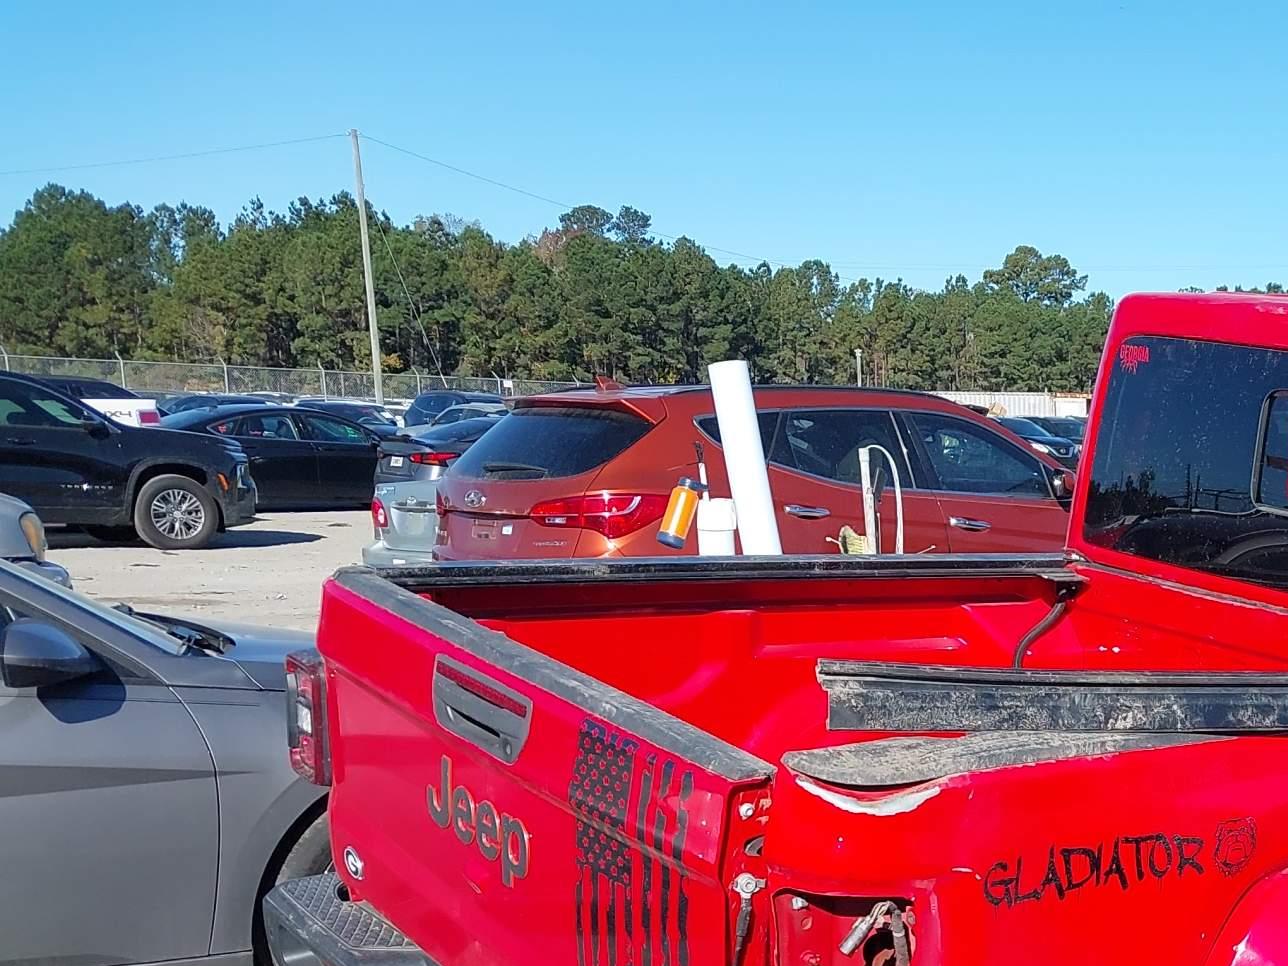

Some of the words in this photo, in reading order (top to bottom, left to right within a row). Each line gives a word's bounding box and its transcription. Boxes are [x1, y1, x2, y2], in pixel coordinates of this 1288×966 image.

[1120, 344, 1149, 362] GEORGIA
[427, 755, 529, 888] Jeep
[984, 833, 1204, 908] GLADIATOR
